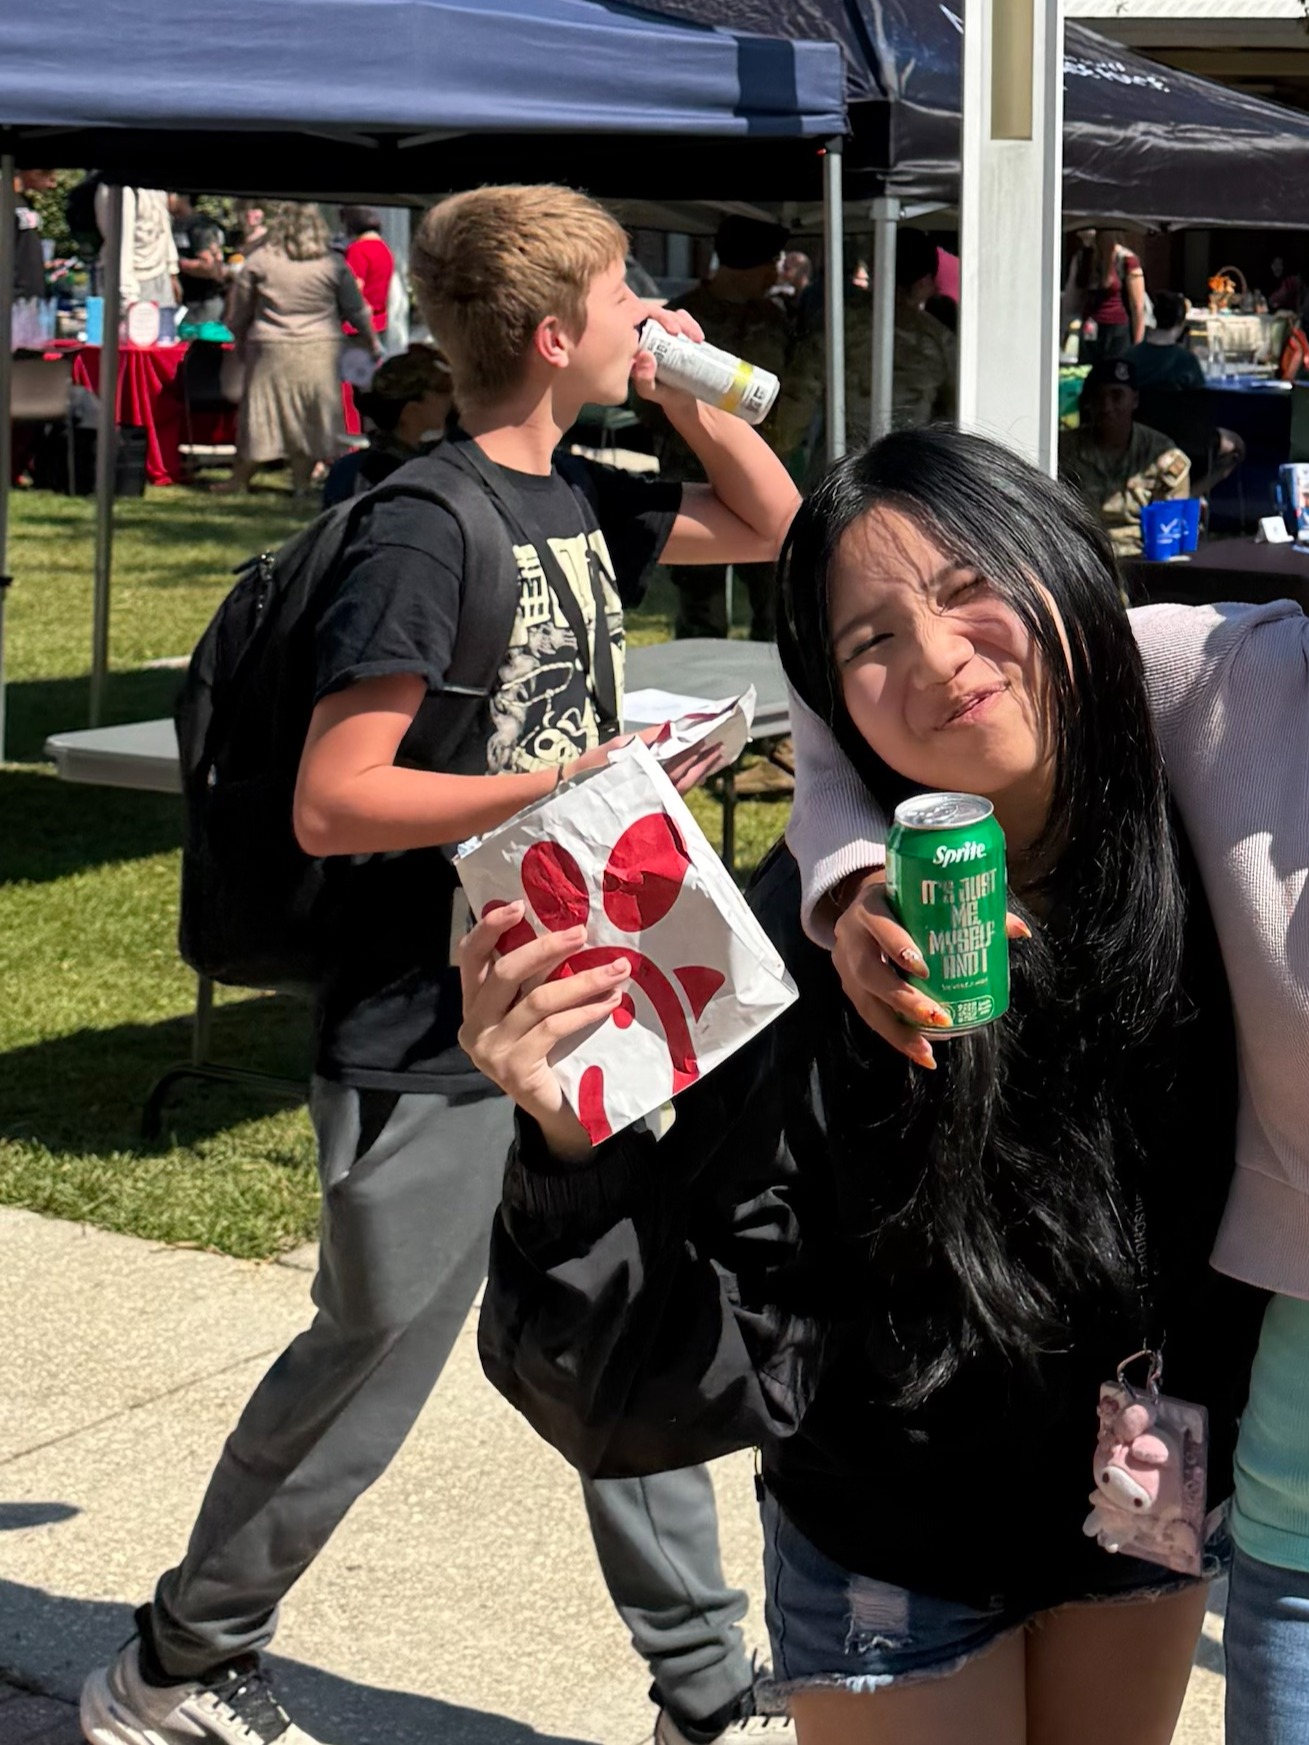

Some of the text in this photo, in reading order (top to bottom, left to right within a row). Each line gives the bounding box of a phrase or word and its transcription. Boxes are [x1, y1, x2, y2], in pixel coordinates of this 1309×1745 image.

[933, 841, 987, 868] Sprite
[921, 868, 997, 905] IT'S JUST
[929, 920, 996, 955] MYSELF
[943, 947, 988, 980] AND I
